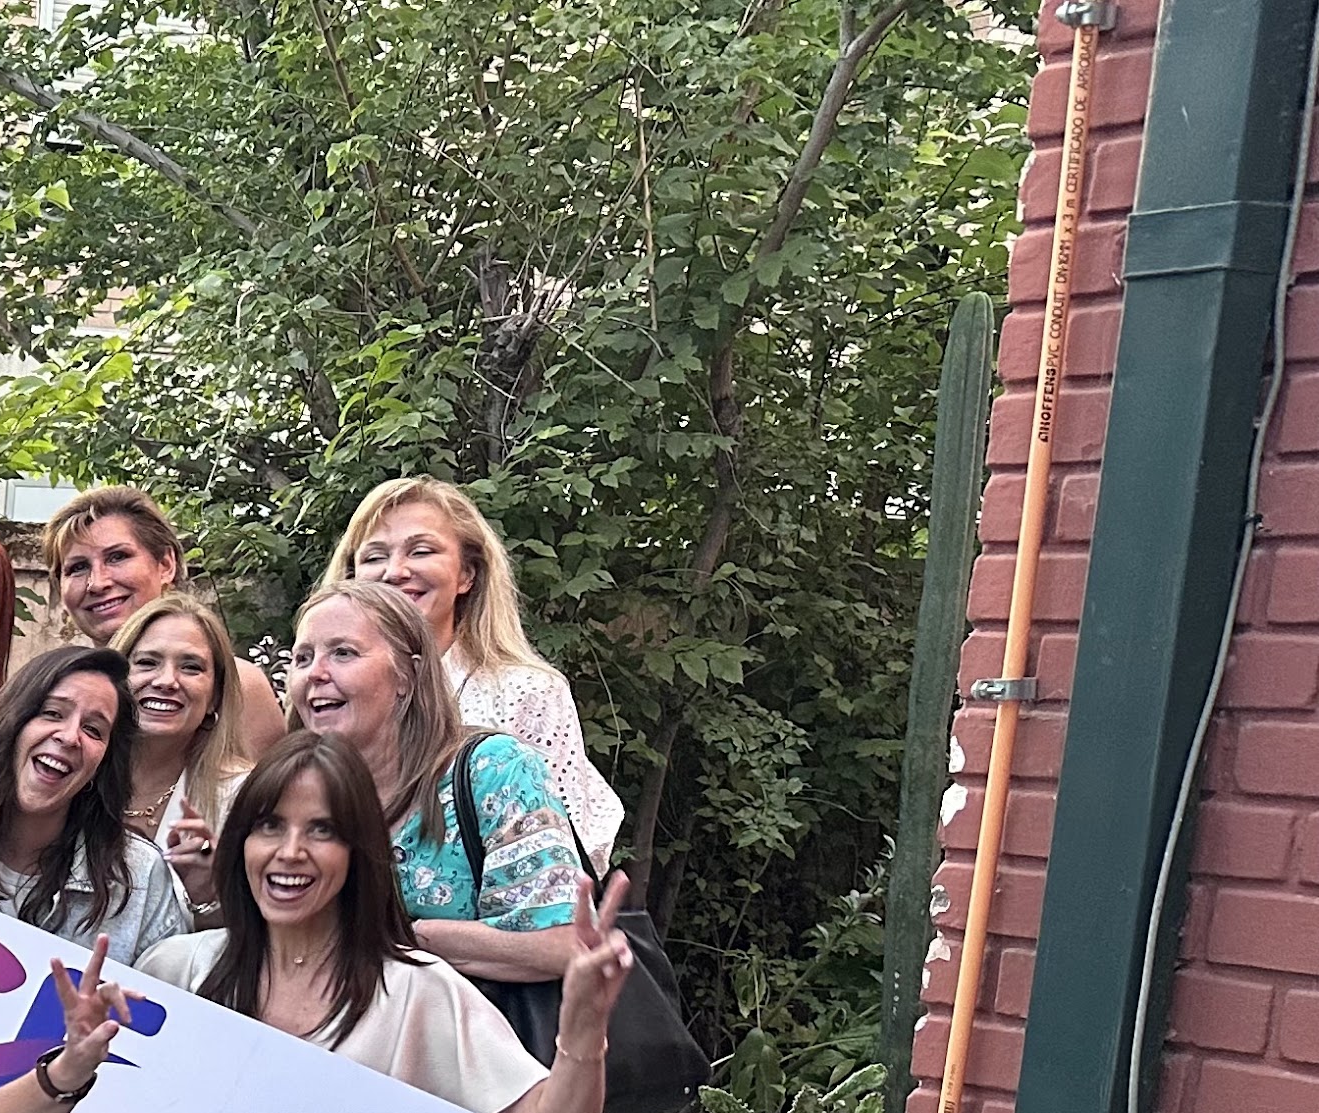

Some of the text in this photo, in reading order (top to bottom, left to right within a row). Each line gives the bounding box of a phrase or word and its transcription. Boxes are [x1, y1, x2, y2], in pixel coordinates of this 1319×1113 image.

[1076, 23, 1094, 90] APROBACIO
[1073, 94, 1086, 112] DE
[1065, 116, 1084, 193] CERTIFICADO
[1066, 197, 1075, 208] m
[1049, 288, 1065, 339] CONDUIT
[1046, 343, 1059, 367] PVC
